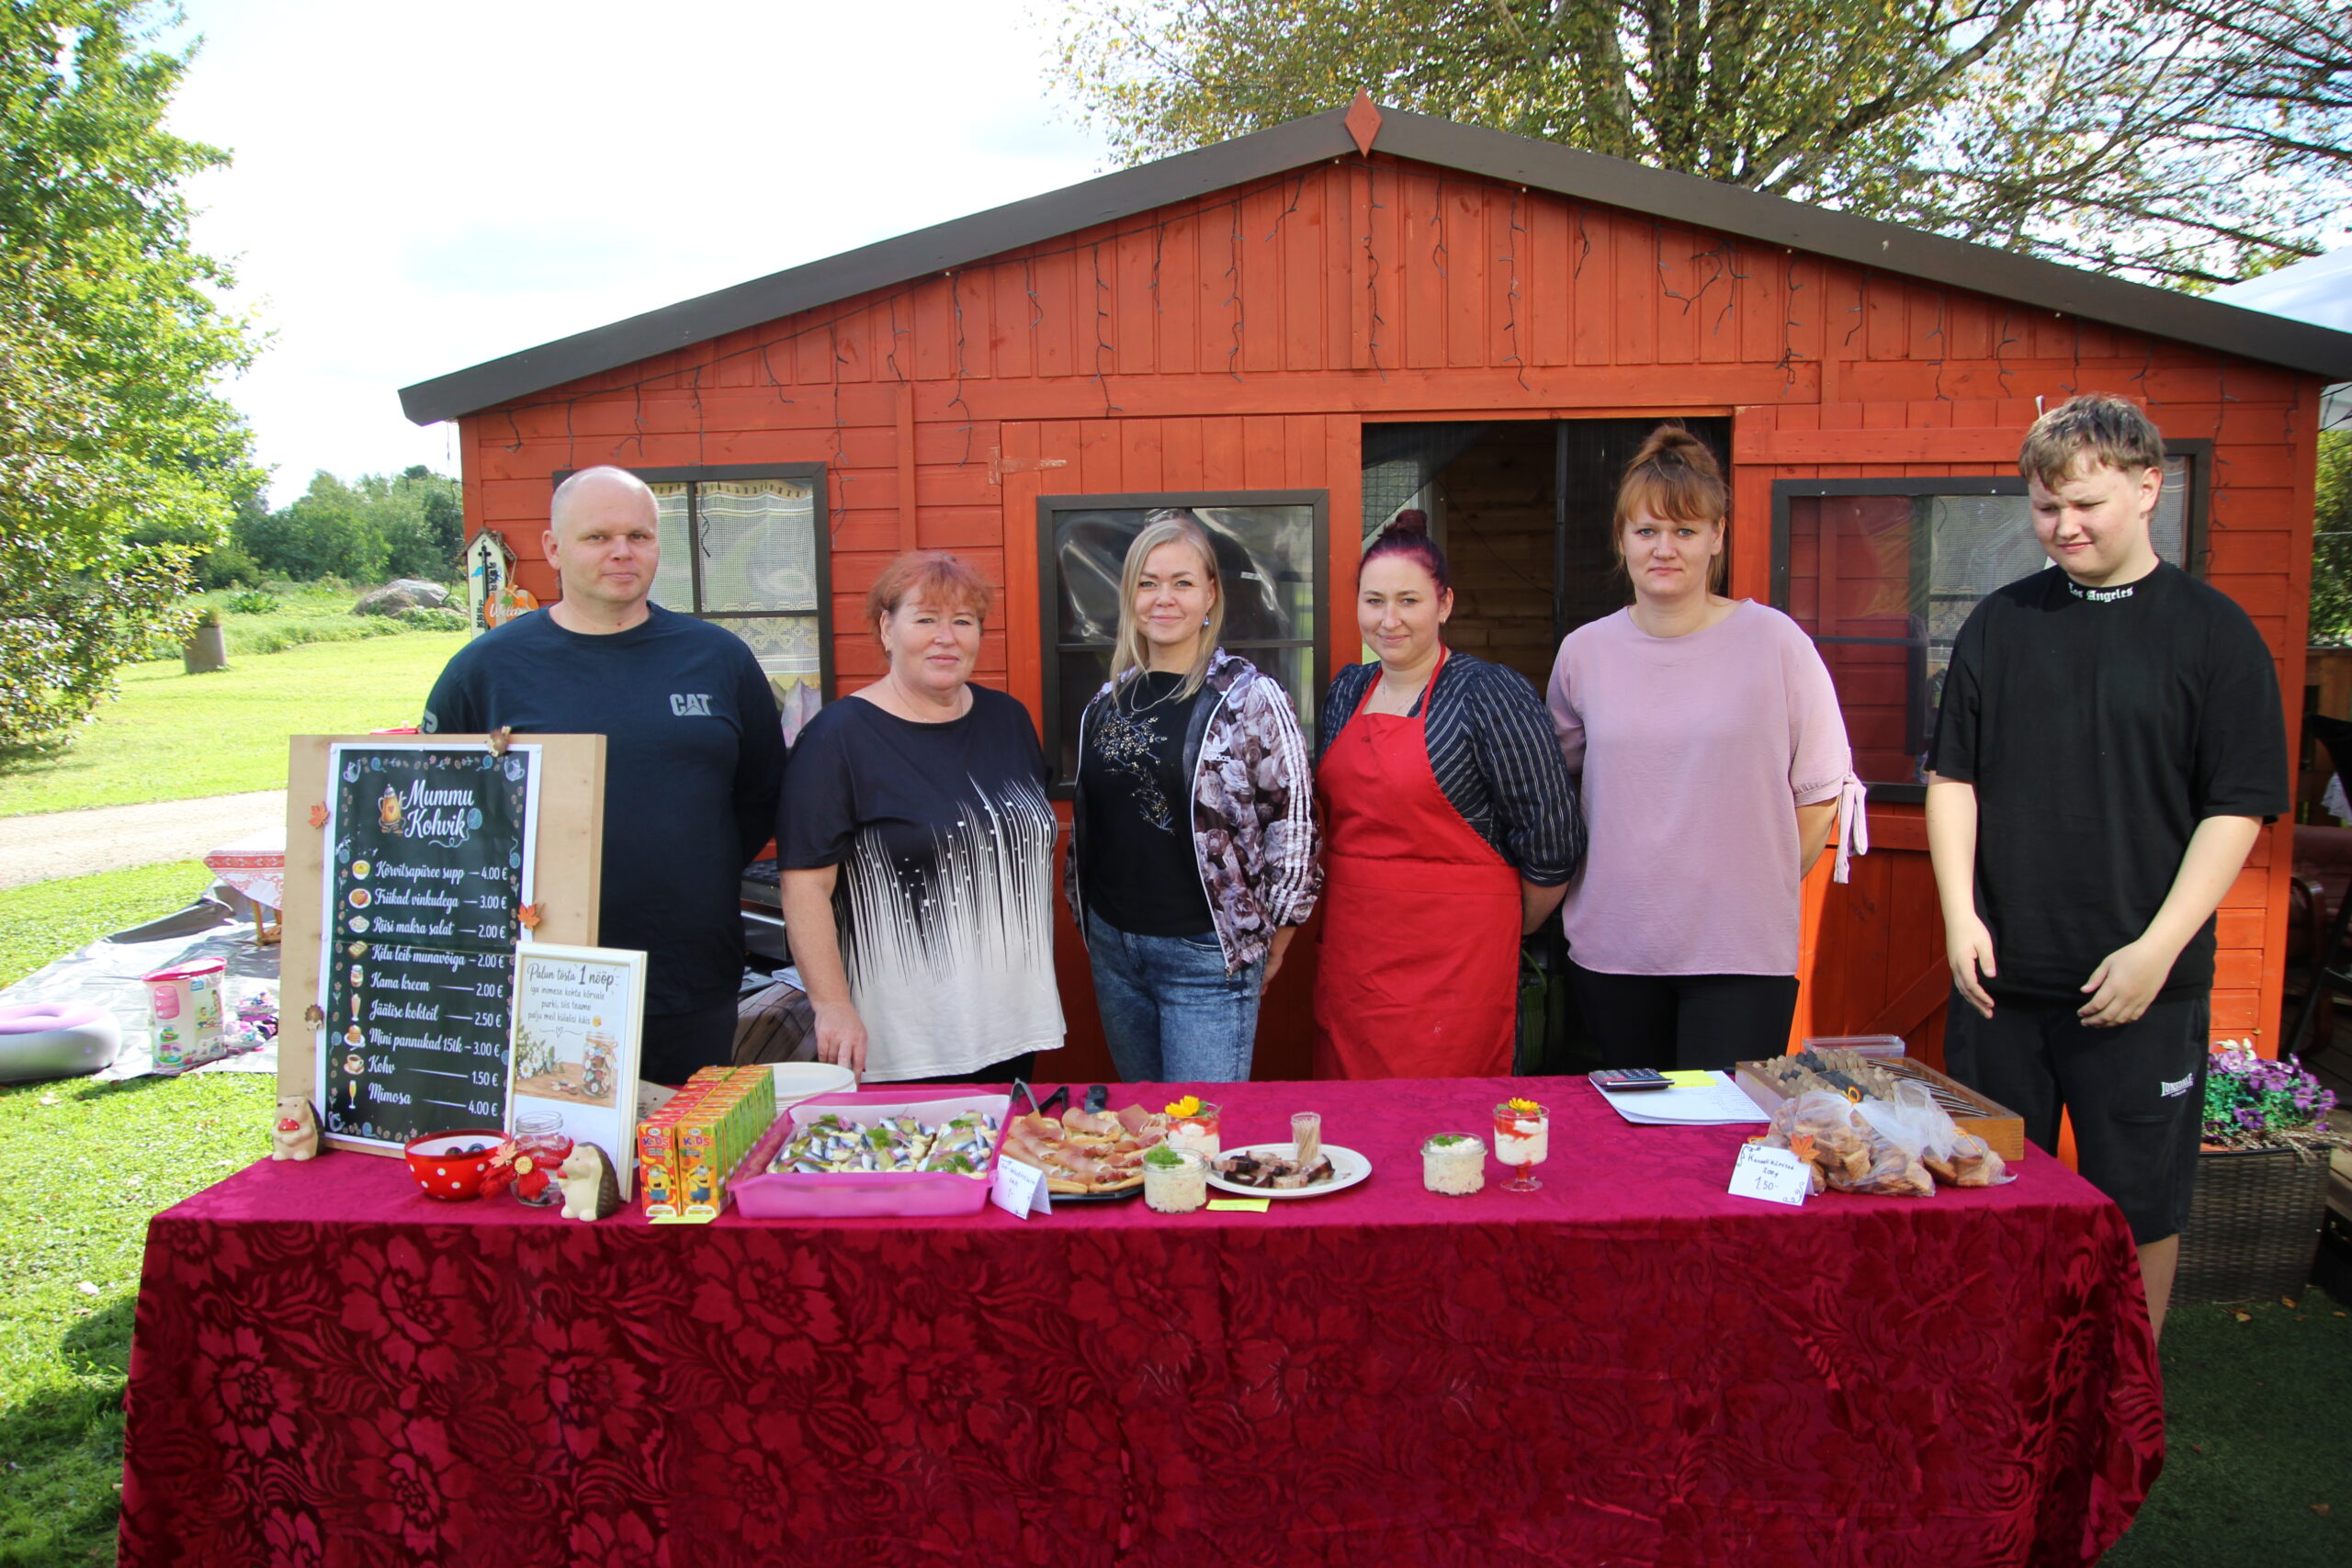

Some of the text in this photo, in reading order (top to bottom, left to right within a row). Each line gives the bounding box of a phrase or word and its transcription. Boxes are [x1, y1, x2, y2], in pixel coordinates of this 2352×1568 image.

[2068, 581, 2133, 603] Los Angeles
[670, 694, 712, 716] CAT
[401, 779, 474, 810] Mummu
[404, 808, 466, 839] Kohvik
[375, 860, 508, 885] Kõrvitsapüree supp 4.00 €
[374, 887, 507, 915] Friikad vinkudega 3.00 €
[373, 917, 506, 939] Riisi makra salat 2.00 €
[372, 943, 504, 973] Kilu leib munavõiga 2.00 €
[370, 971, 503, 998] Kama kreem 2.00 €
[526, 963, 554, 981] Palun
[578, 964, 586, 985] 1
[589, 971, 614, 992] nööp
[530, 985, 605, 1000] iga inimese kohta kõrvale
[560, 999, 570, 1008] siis
[571, 1000, 591, 1010] teame
[369, 999, 502, 1028] Jäätise kokteil 2.50 €
[527, 1011, 591, 1025] palju meil külalisi käis
[369, 1027, 501, 1057] Mini pannukad 15tk 3.00 €
[368, 1055, 499, 1087] Kohv 1.50 €
[368, 1082, 498, 1116] Mimosa 4.00 €
